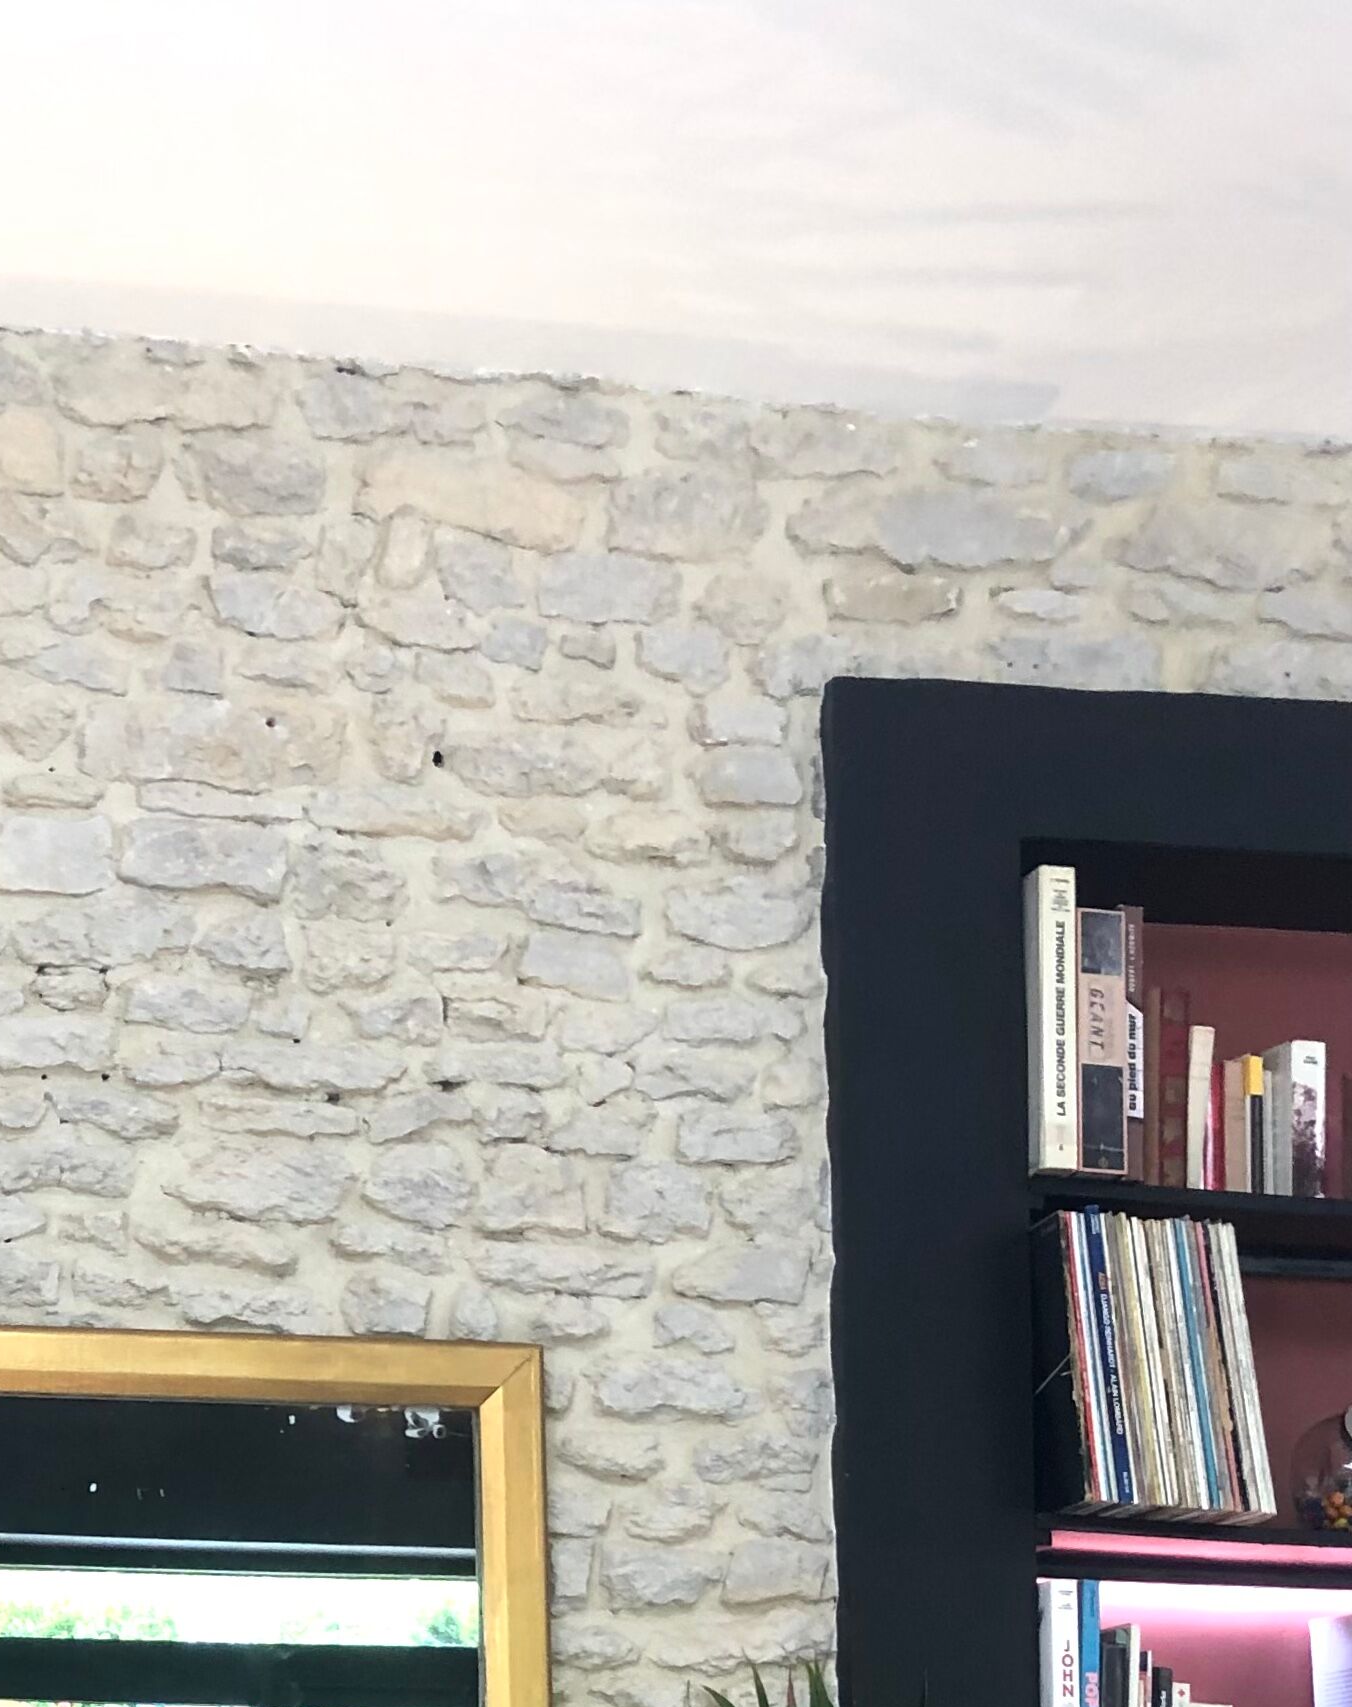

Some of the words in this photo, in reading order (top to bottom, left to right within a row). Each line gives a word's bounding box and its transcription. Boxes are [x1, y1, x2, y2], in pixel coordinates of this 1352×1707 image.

[1056, 920, 1066, 984] MONDIALE
[1056, 987, 1066, 1036] GUERRE
[1128, 1013, 1137, 1041] mur
[1056, 1039, 1066, 1097] SECONDE
[1128, 1043, 1137, 1060] du
[1128, 1062, 1138, 1091] pied
[1056, 1100, 1066, 1117] LA
[1061, 1640, 1074, 1697] JOHN
